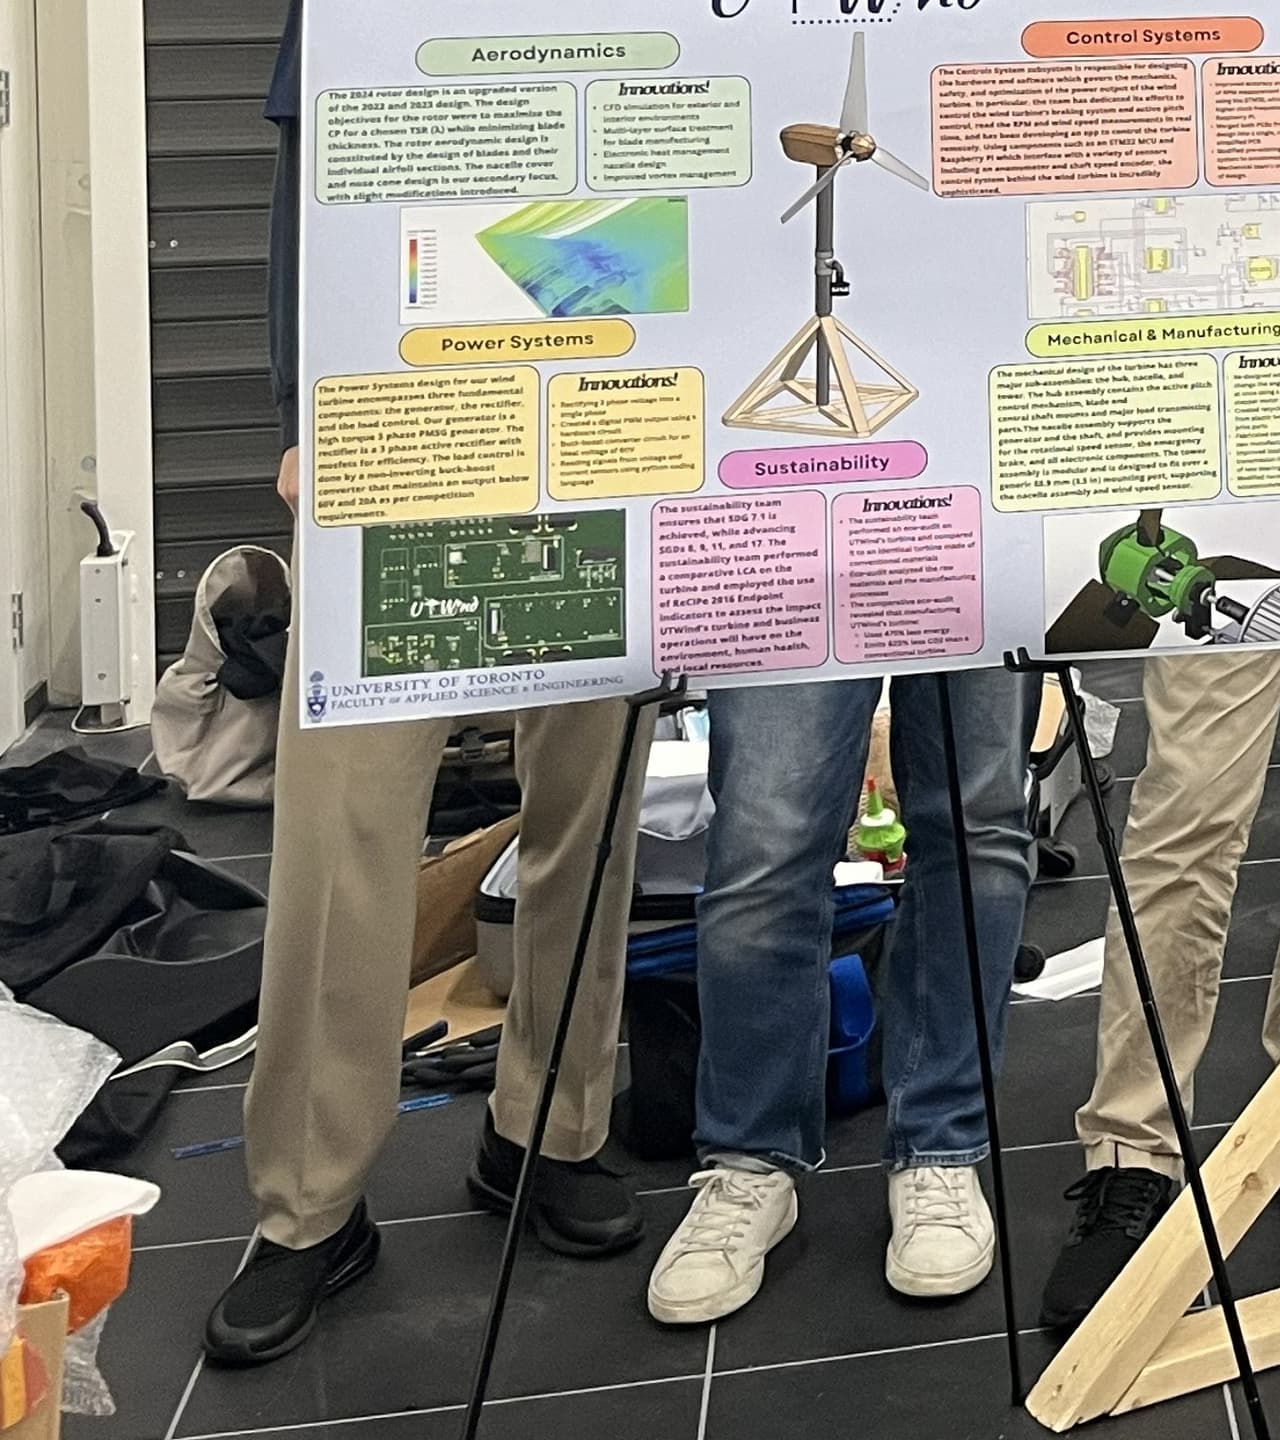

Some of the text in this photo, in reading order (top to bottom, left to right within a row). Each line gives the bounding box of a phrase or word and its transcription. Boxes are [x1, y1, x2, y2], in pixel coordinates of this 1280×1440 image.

[1067, 28, 1221, 46] Control Systems
[472, 43, 625, 63] Aerodynamics
[618, 80, 710, 96] Innovations!
[442, 335, 593, 351] Power Systems
[1048, 329, 1142, 346] Mechanical
[1147, 329, 1156, 341] &
[578, 372, 678, 392] Innovations!
[755, 455, 889, 476] Sustainability
[862, 493, 952, 512] Innovations!
[331, 697, 385, 709] FACULTY
[404, 691, 458, 703] APPLIED
[463, 686, 516, 698] SCIENCE
[534, 675, 623, 691] ENGINEERING
[332, 669, 545, 697] UNIVERSITY OF TORONTO
